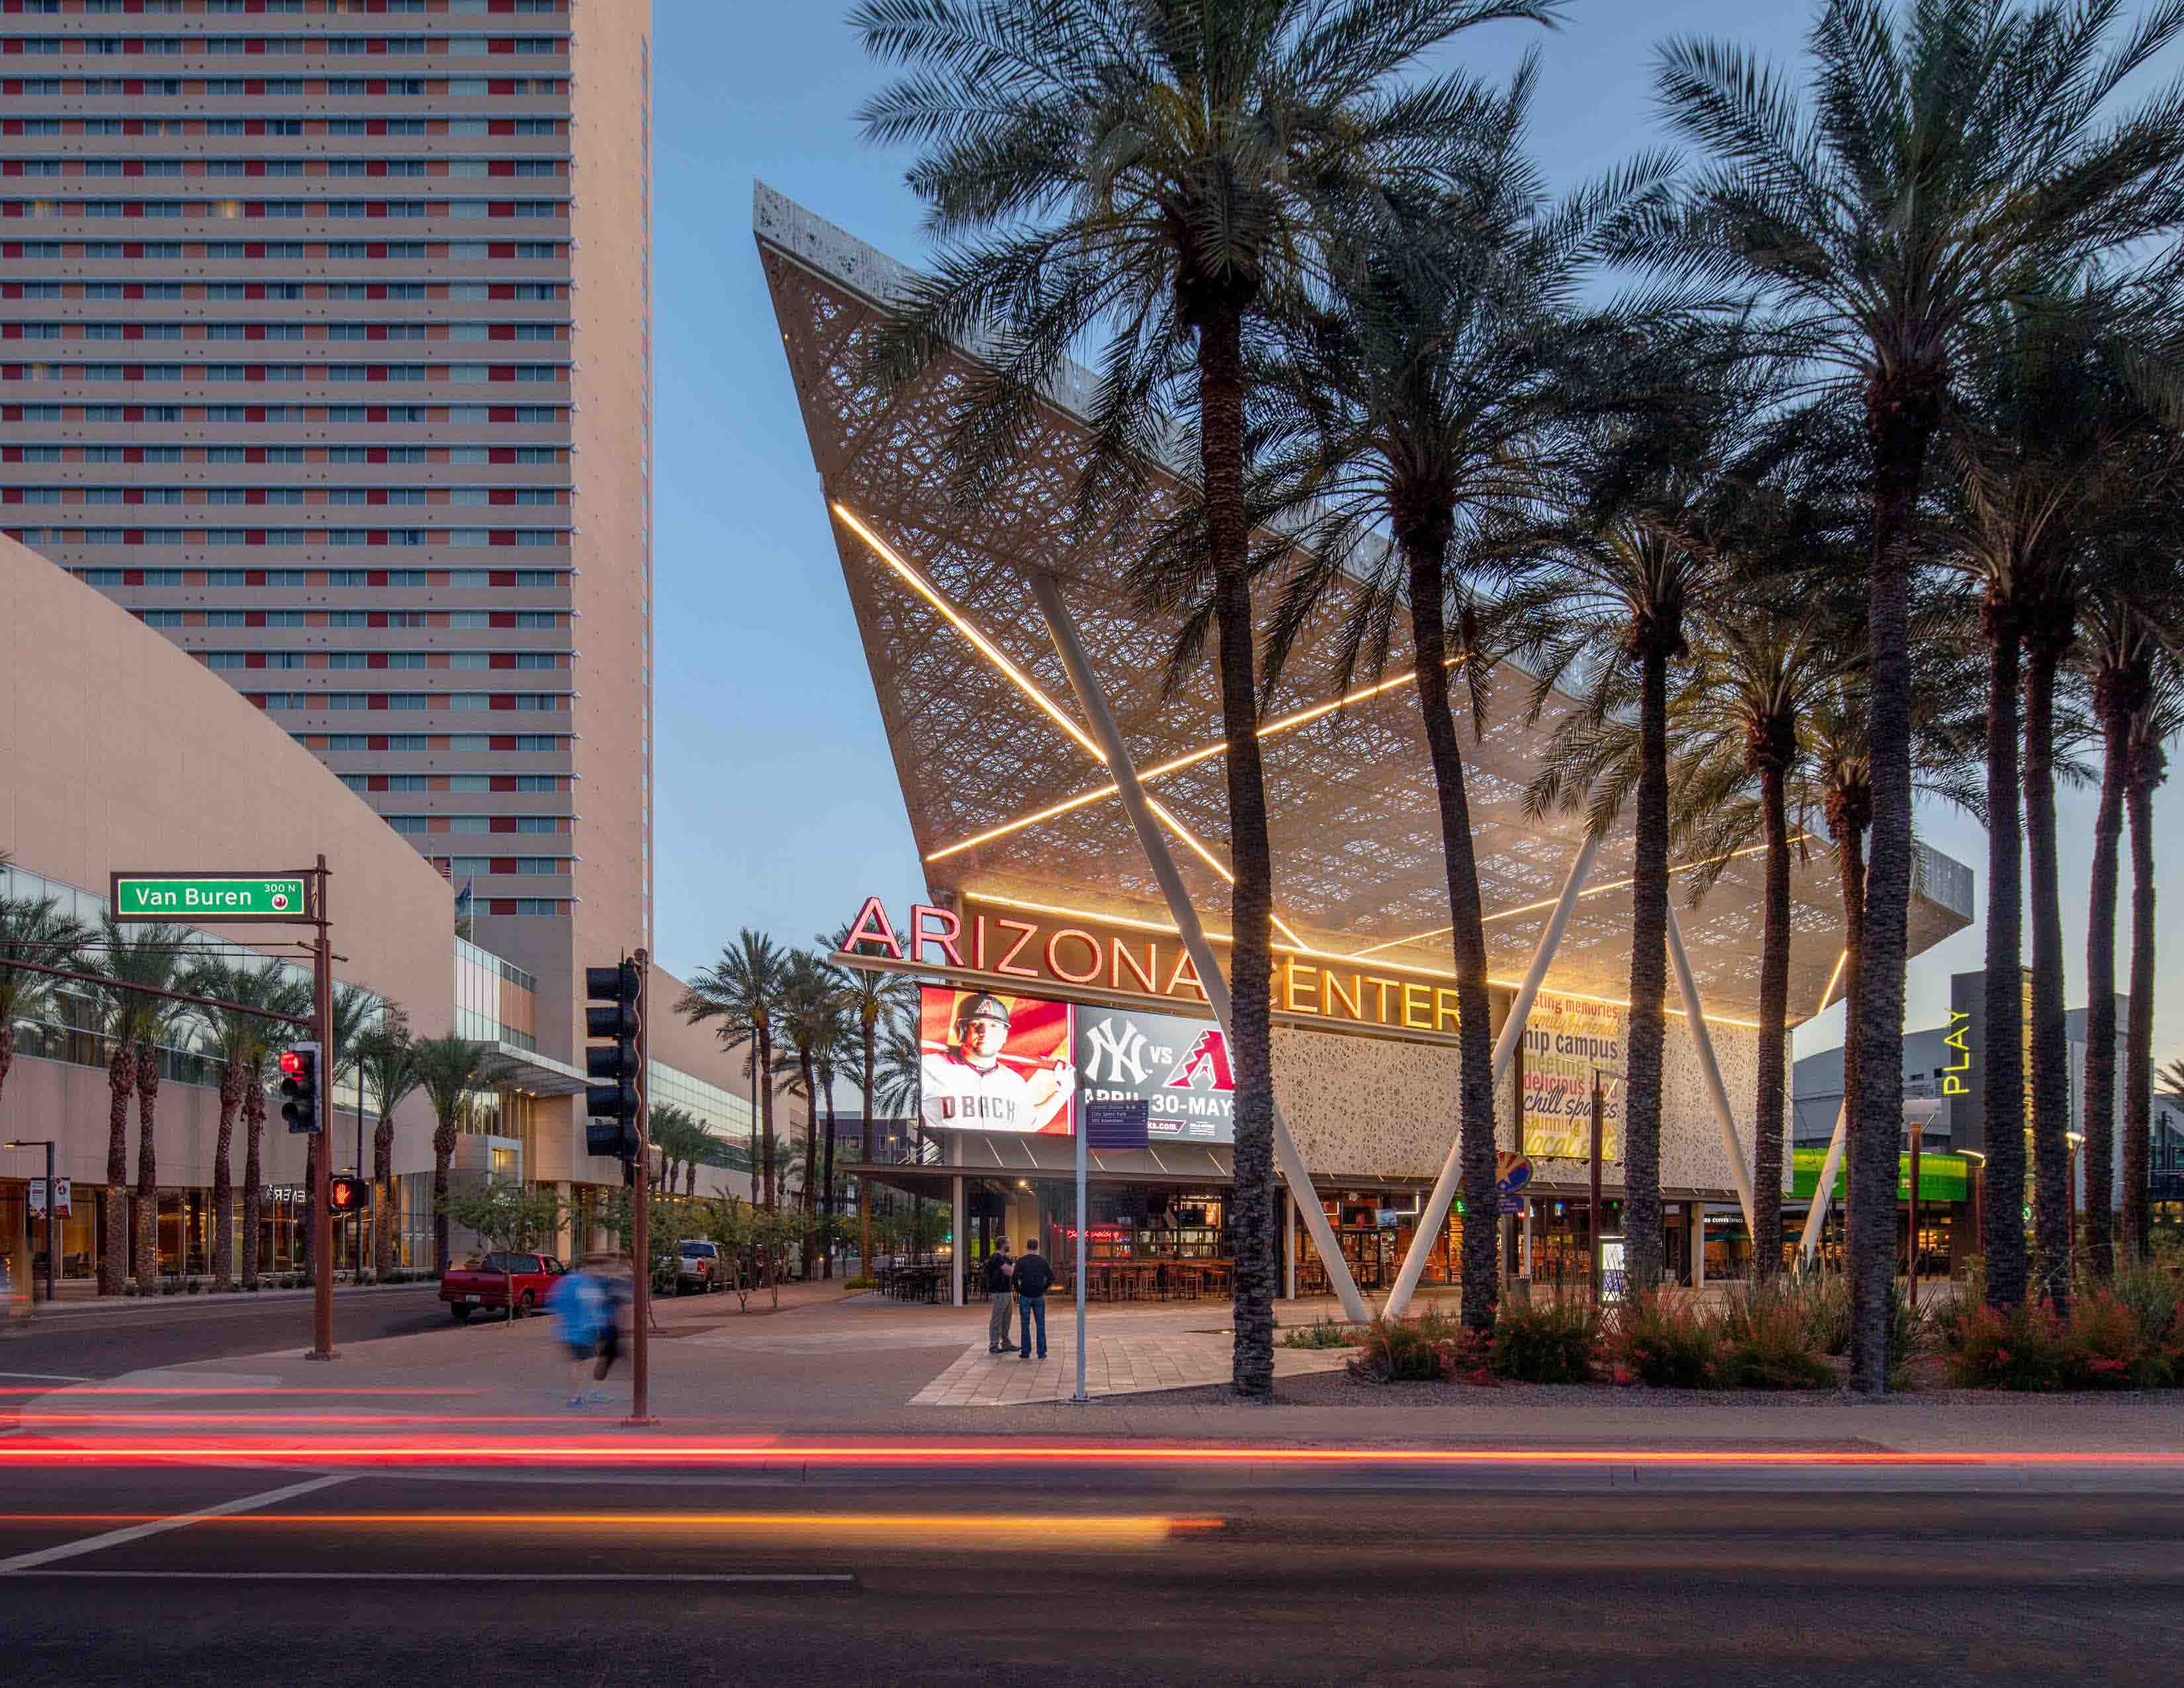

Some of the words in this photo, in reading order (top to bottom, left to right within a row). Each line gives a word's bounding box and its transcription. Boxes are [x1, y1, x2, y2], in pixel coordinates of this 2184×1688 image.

[136, 887, 177, 906] Van
[185, 887, 252, 906] Buren
[265, 884, 285, 892] 300
[842, 896, 1209, 1000] ARIZONA
[1269, 962, 1461, 1031] ENTER
[1533, 994, 1563, 1017] sting
[1555, 1033, 1619, 1062] campus
[1942, 1006, 1970, 1096] PLAY
[1524, 1069, 1584, 1096] delicious
[1524, 1084, 1563, 1114] chill
[1566, 1096, 1619, 1125] spaes
